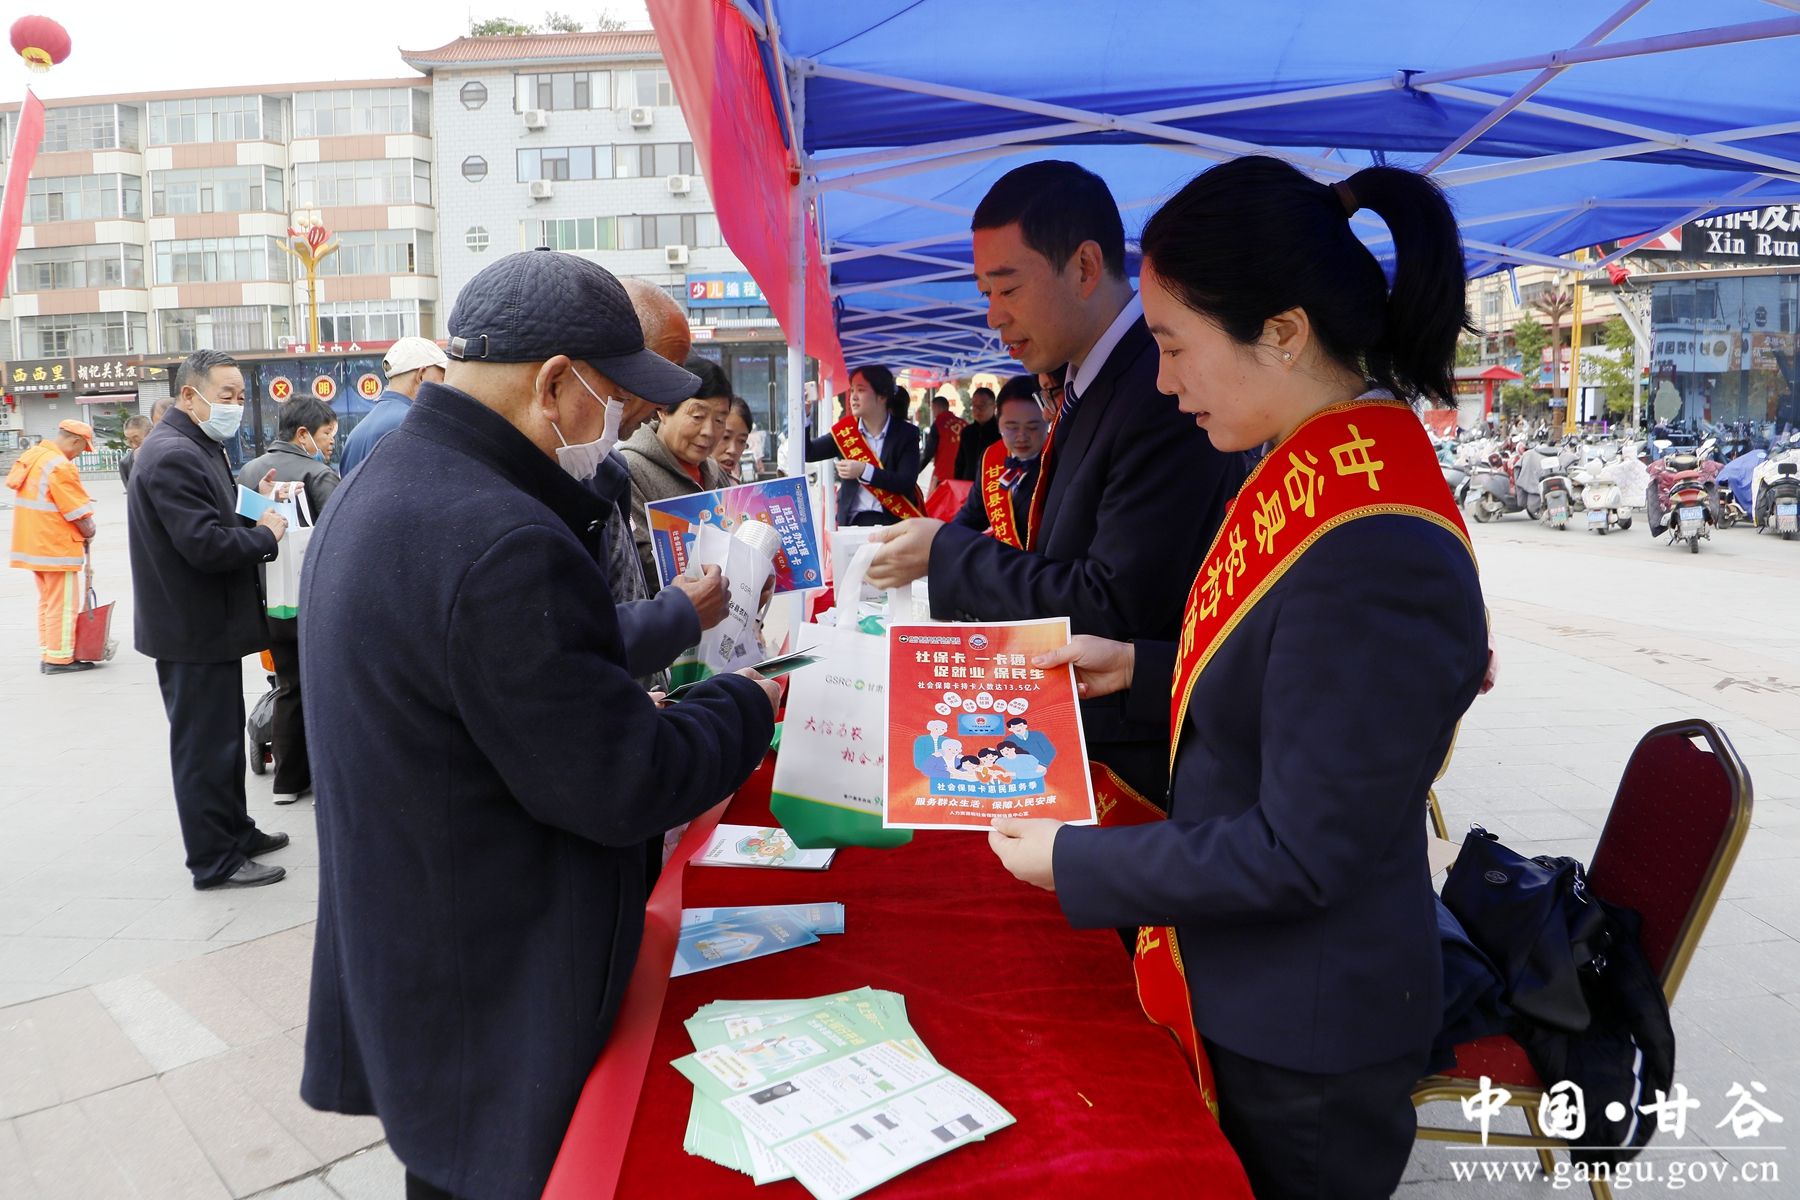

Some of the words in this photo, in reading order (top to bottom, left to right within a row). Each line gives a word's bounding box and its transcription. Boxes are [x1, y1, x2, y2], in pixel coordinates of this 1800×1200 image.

[1706, 230, 1746, 255] Xin
[1756, 233, 1799, 257] Run
[691, 281, 757, 299] 少儿编程
[13, 365, 65, 382] 西西里
[769, 504, 802, 566] 用电子社保卡
[782, 506, 799, 531] 找工作
[792, 532, 810, 557] 办社保
[915, 650, 966, 664] 社保卡
[975, 653, 1026, 666] 一卡通
[933, 665, 985, 679] 促就业
[994, 667, 1045, 680] 保民生
[825, 675, 852, 688] GSRC
[917, 681, 1041, 691] 社会保障卡持卡人数达13.5亿人
[937, 782, 1037, 794] 社会保障卡惠民服务季
